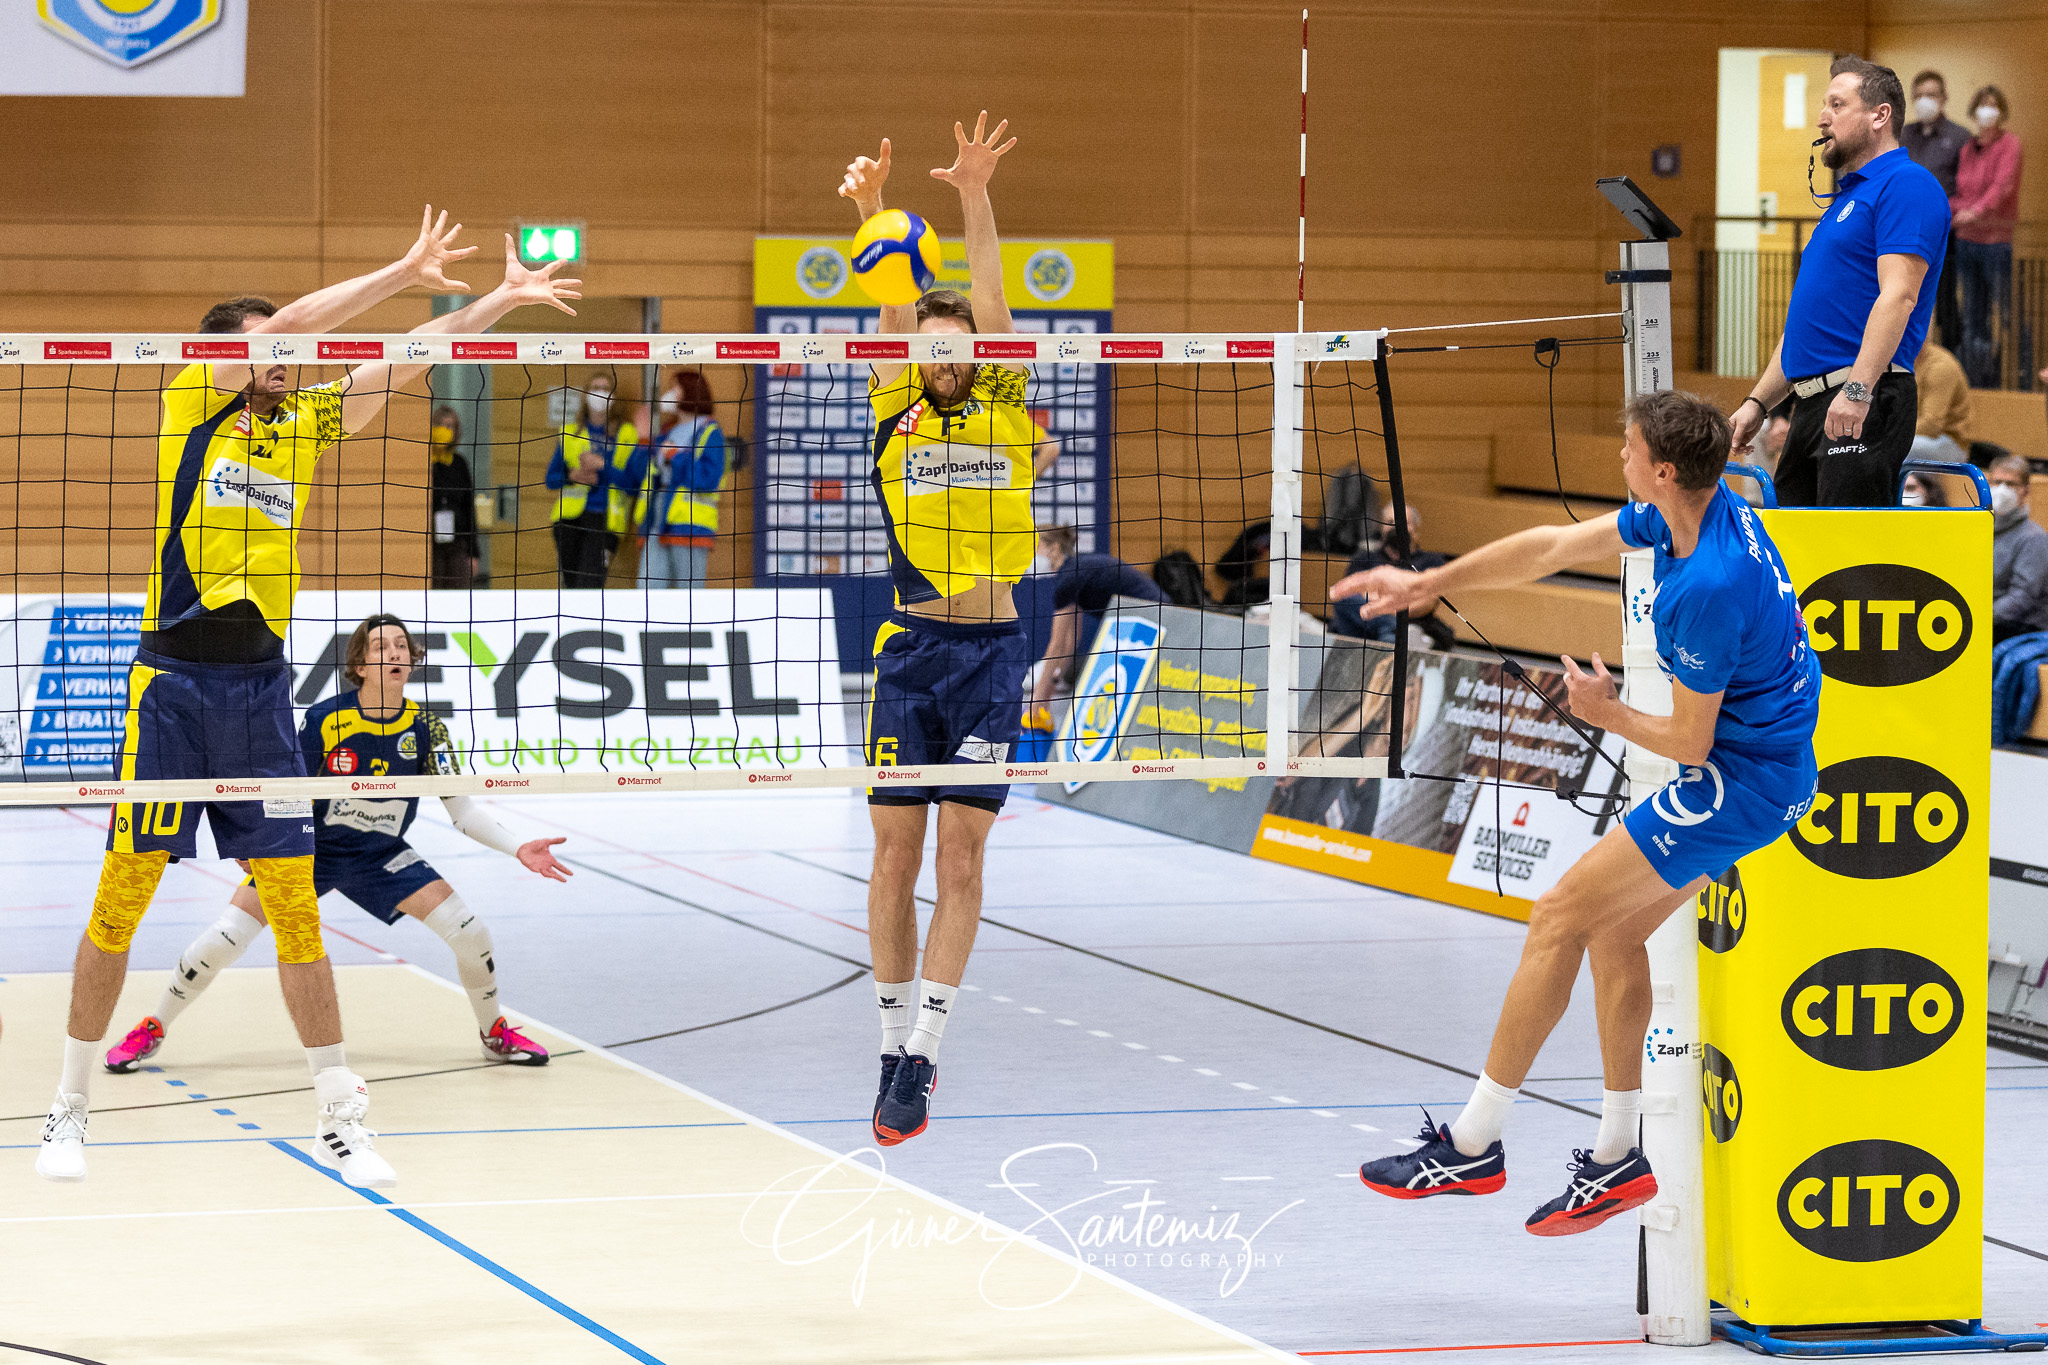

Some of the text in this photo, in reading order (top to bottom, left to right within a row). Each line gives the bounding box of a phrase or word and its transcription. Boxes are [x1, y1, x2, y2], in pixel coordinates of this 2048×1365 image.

[4, 349, 20, 357] Zapf
[142, 349, 158, 357] Zapf
[278, 349, 295, 357] Zapf
[413, 349, 430, 357] Zapf
[547, 349, 563, 357] Zapf
[678, 349, 694, 357] Zapf
[808, 349, 824, 357] Zapf
[937, 348, 953, 356] Zapf
[1064, 348, 1080, 356] Zapf
[1190, 347, 1206, 355] Zapf
[1827, 445, 1859, 455] CRAFT
[917, 460, 1006, 478] Zapf Daigfuss
[248, 485, 293, 511] Daigfuss
[1803, 599, 1963, 652] CITO
[484, 738, 579, 767] UND
[596, 736, 802, 766] HOLZBAU
[1015, 769, 1049, 777] Marmot
[1141, 765, 1175, 773] Marmot
[758, 774, 793, 782] Marmot
[887, 771, 922, 779] Marmot
[494, 779, 530, 787] Marmot
[627, 777, 662, 785] Marmot
[226, 785, 262, 793] Marmot
[361, 782, 397, 790] Marmot
[89, 787, 125, 796] Marmot
[141, 801, 184, 836] 10
[1797, 791, 1959, 845] CITO
[1652, 834, 1671, 857] erima
[922, 1003, 948, 1014] erima
[1792, 982, 1954, 1037] CITO
[1657, 1043, 1690, 1057] Zapf
[1788, 1173, 1949, 1230] CITO
